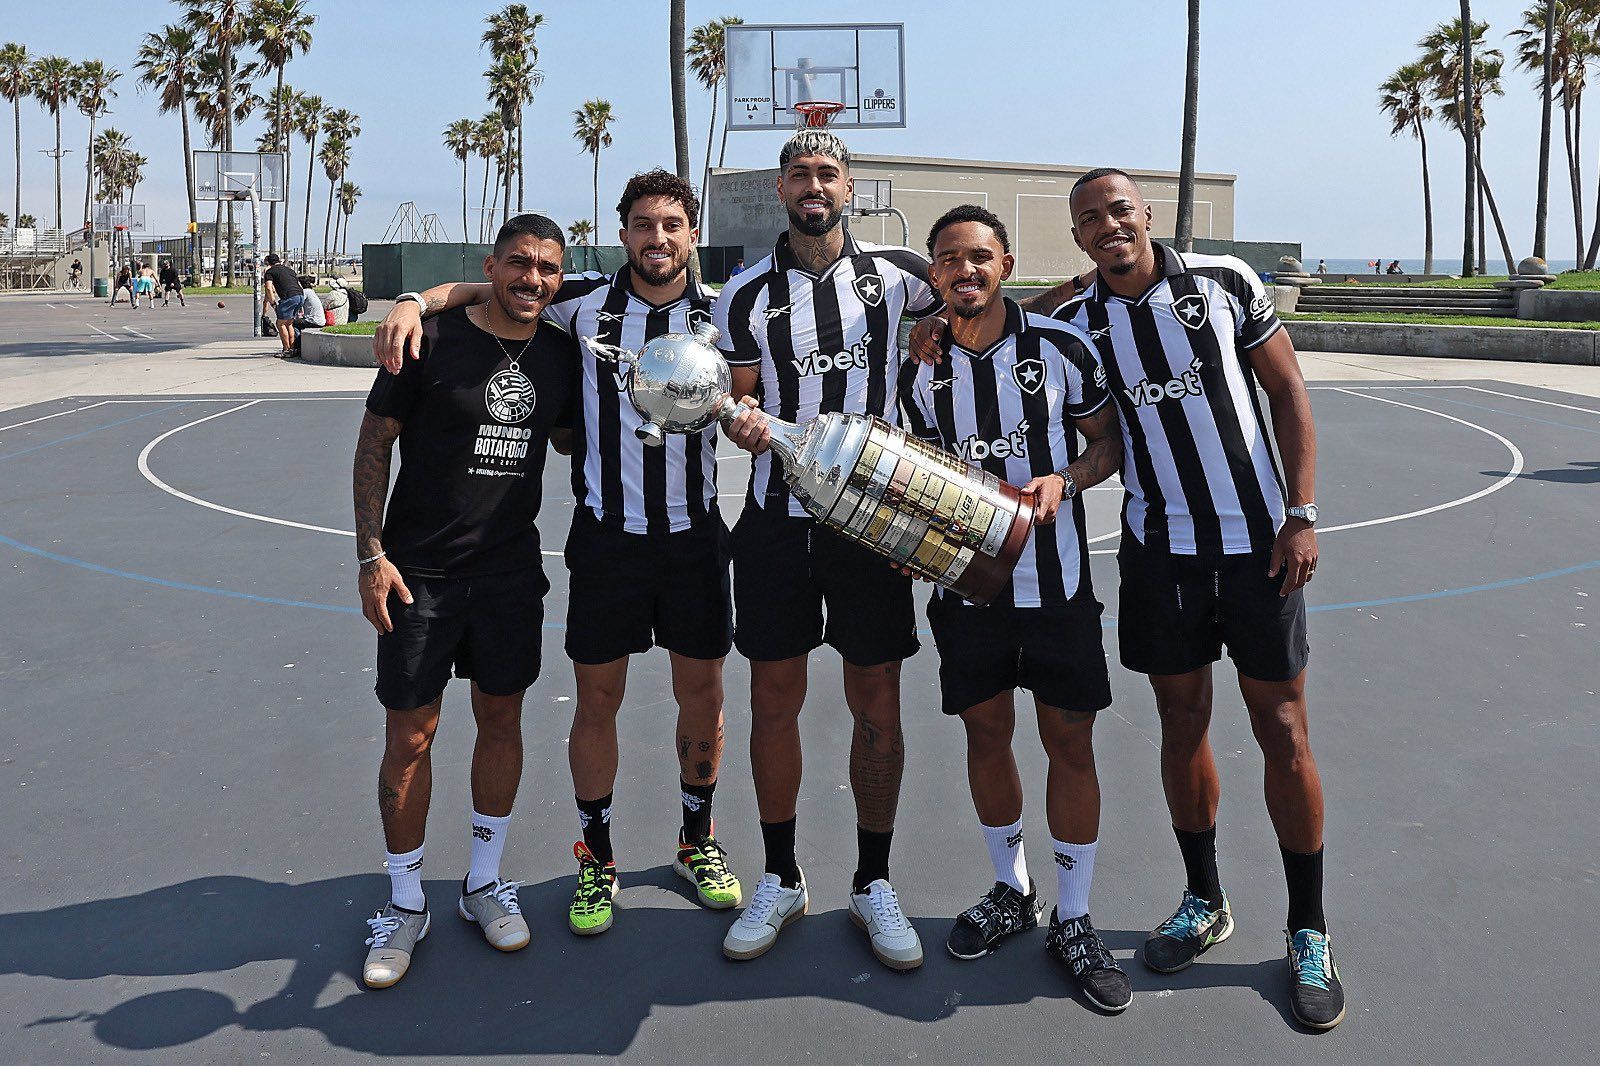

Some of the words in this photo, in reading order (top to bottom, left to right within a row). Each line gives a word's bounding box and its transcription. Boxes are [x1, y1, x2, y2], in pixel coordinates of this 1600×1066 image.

[746, 103, 759, 111] LA
[863, 98, 896, 110] CLIPPERS
[478, 424, 532, 440] MUNDO
[474, 437, 529, 459] BOTAFOGO
